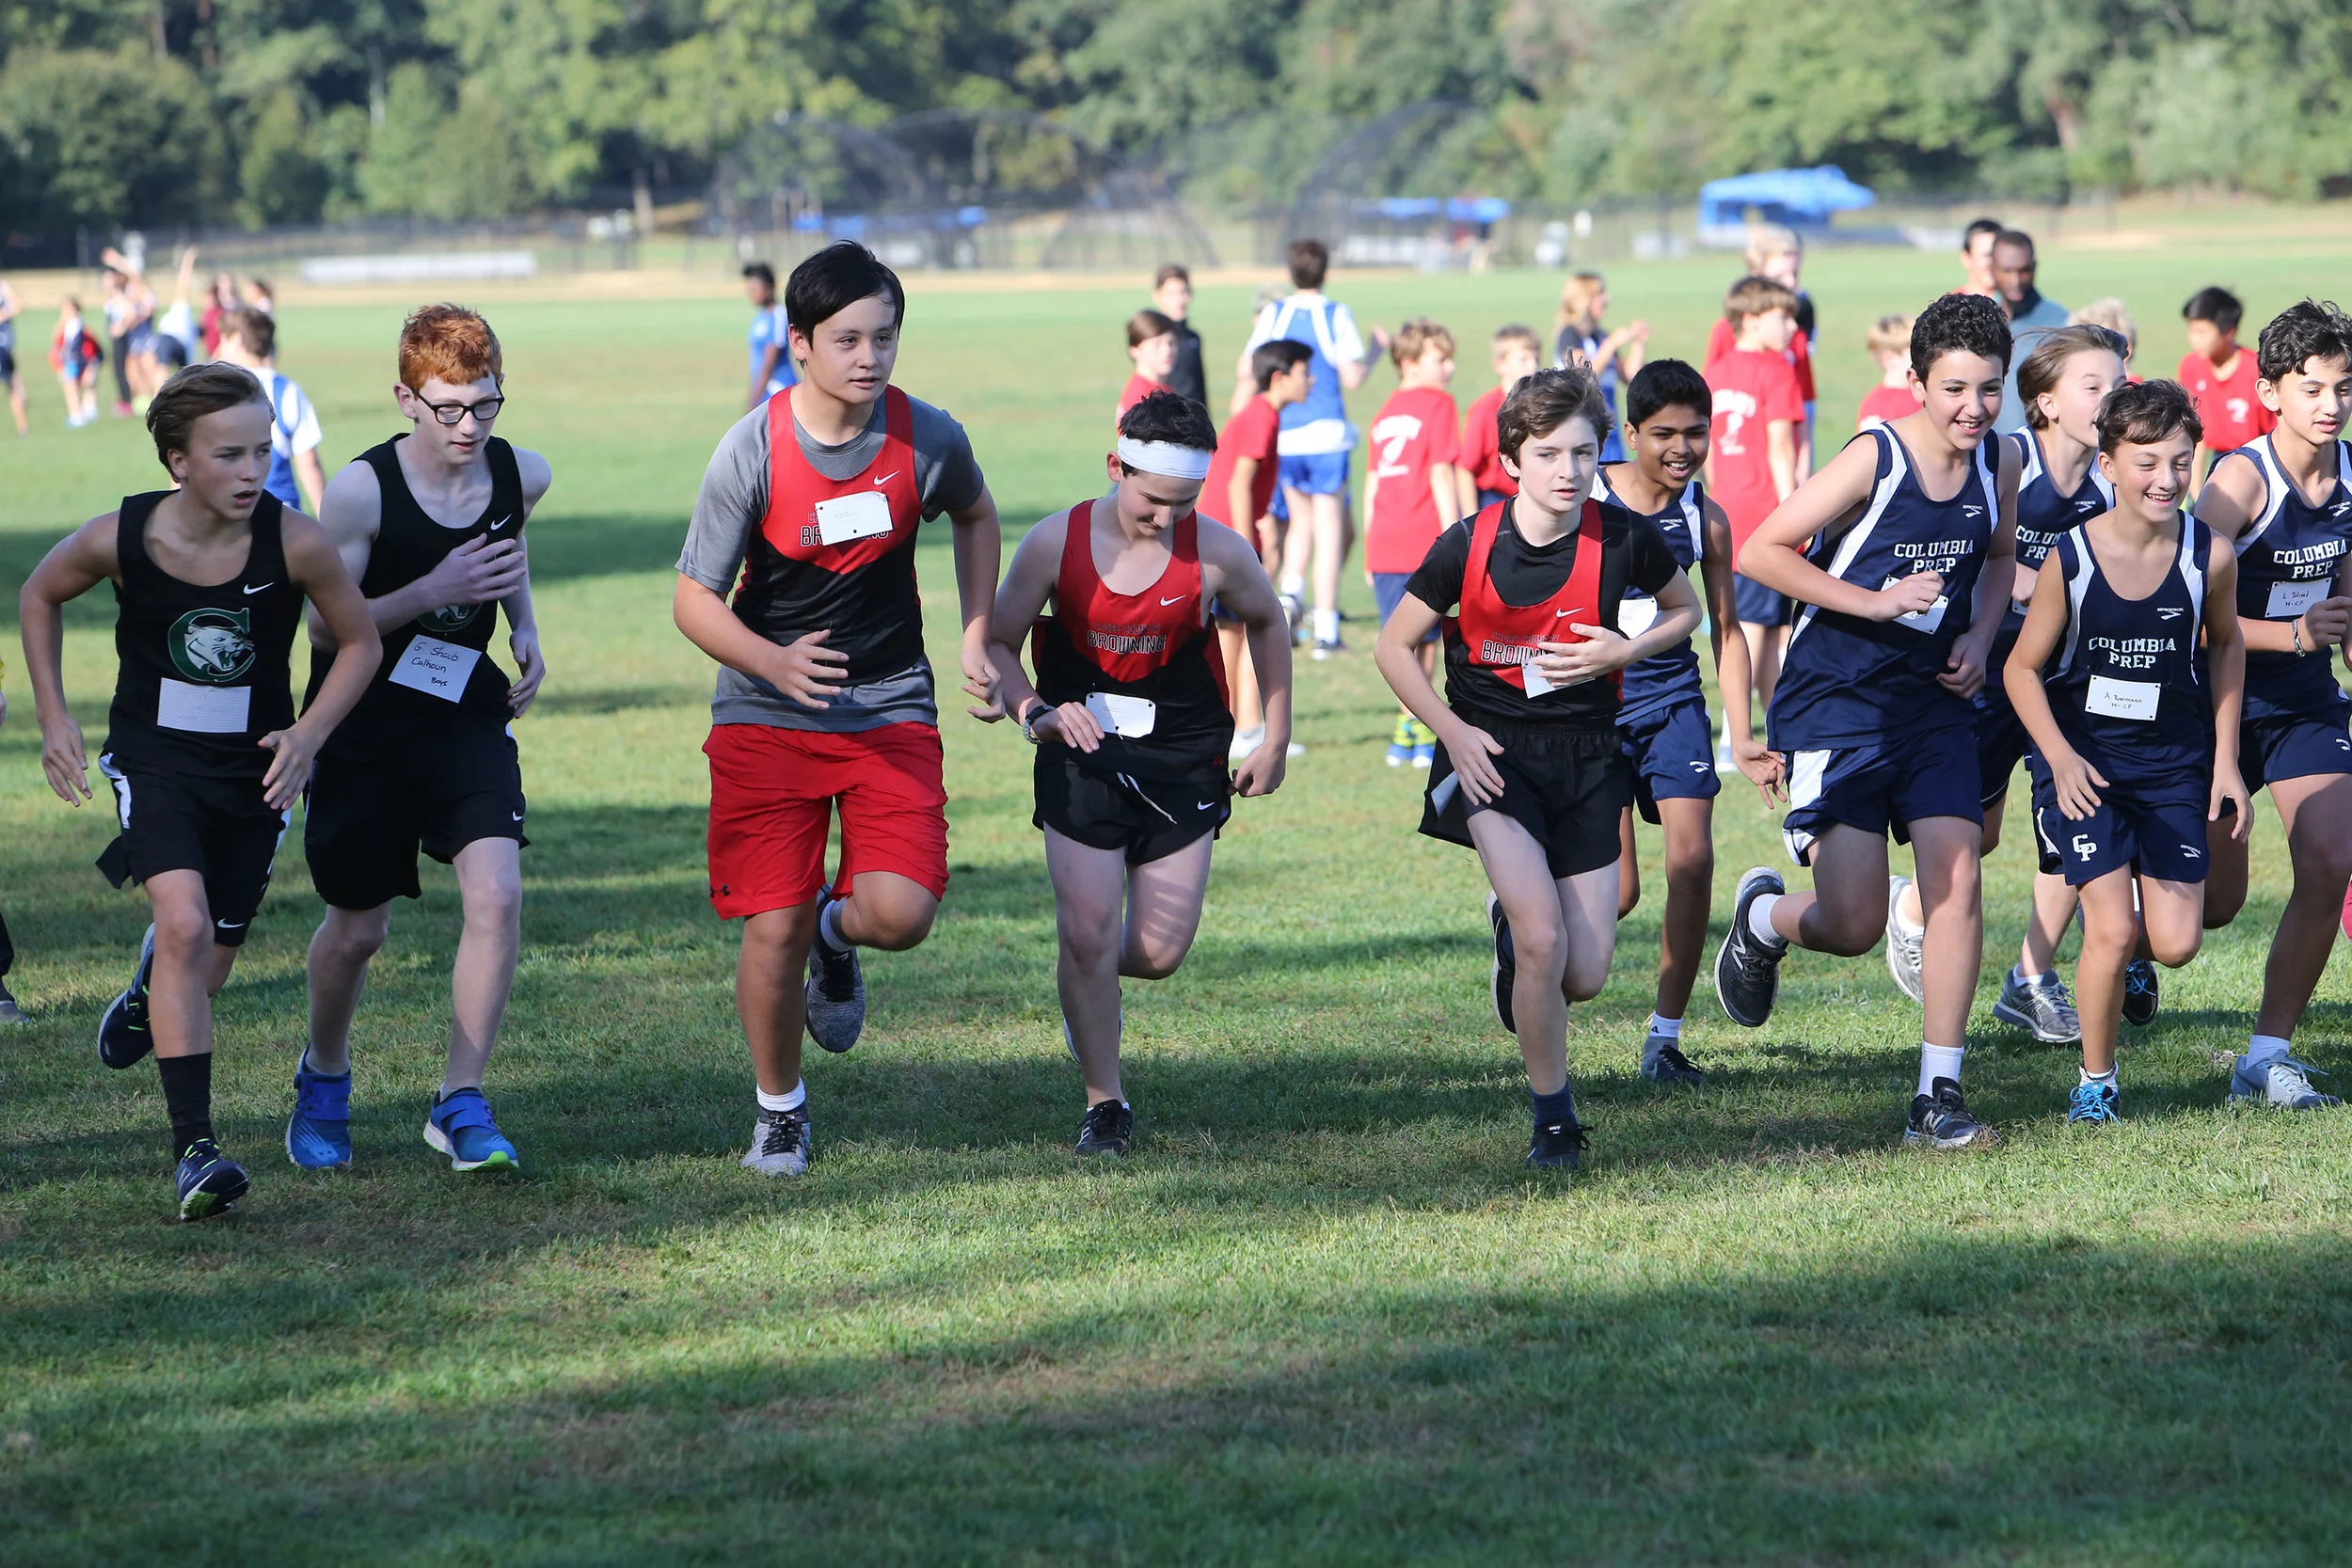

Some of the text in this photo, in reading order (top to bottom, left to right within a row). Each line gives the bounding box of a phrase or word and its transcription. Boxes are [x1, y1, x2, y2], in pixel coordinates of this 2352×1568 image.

[2015, 525, 2062, 546] COLUM
[1894, 539, 1974, 559] COLUMBIA
[2025, 546, 2052, 560] PR
[2273, 538, 2347, 565] COLUMBIA
[1911, 557, 1957, 574] PREP
[2291, 560, 2334, 579] PREP
[1087, 629, 1167, 655] BROWNING
[2089, 637, 2177, 654] COLUMBIA
[411, 657, 447, 674] Calhoun
[2108, 651, 2156, 670] PREP
